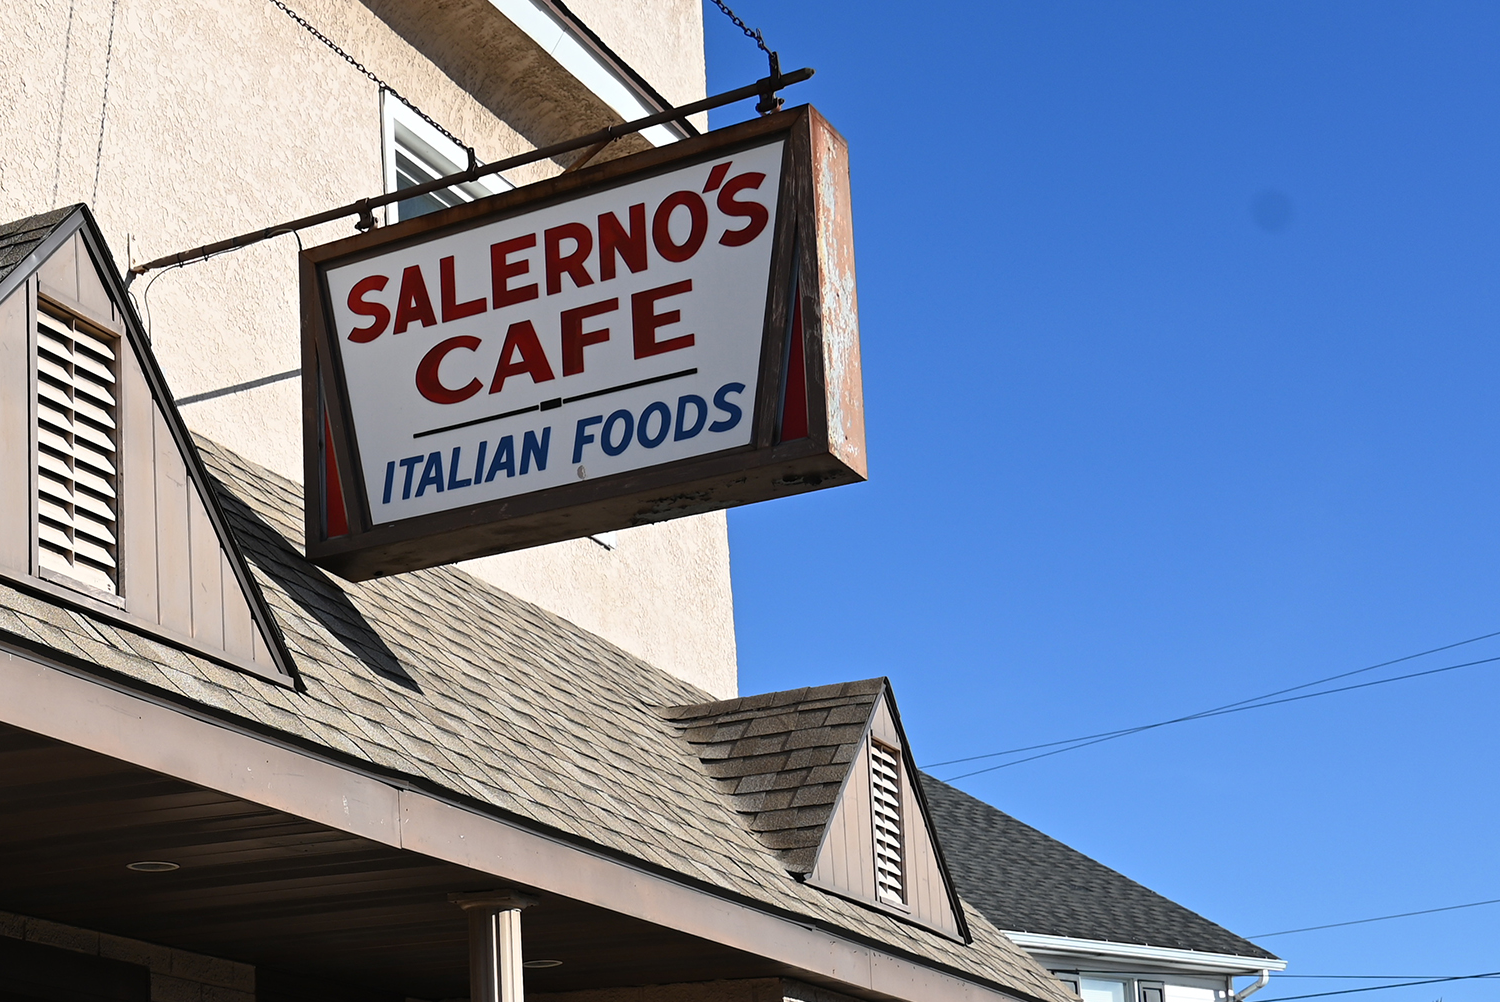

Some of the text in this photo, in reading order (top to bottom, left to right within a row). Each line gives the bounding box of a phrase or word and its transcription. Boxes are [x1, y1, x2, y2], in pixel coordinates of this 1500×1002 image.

[346, 161, 769, 344] SALERNO'S
[415, 279, 695, 405] CAFE
[382, 382, 746, 505] ITALIAN FOODS
